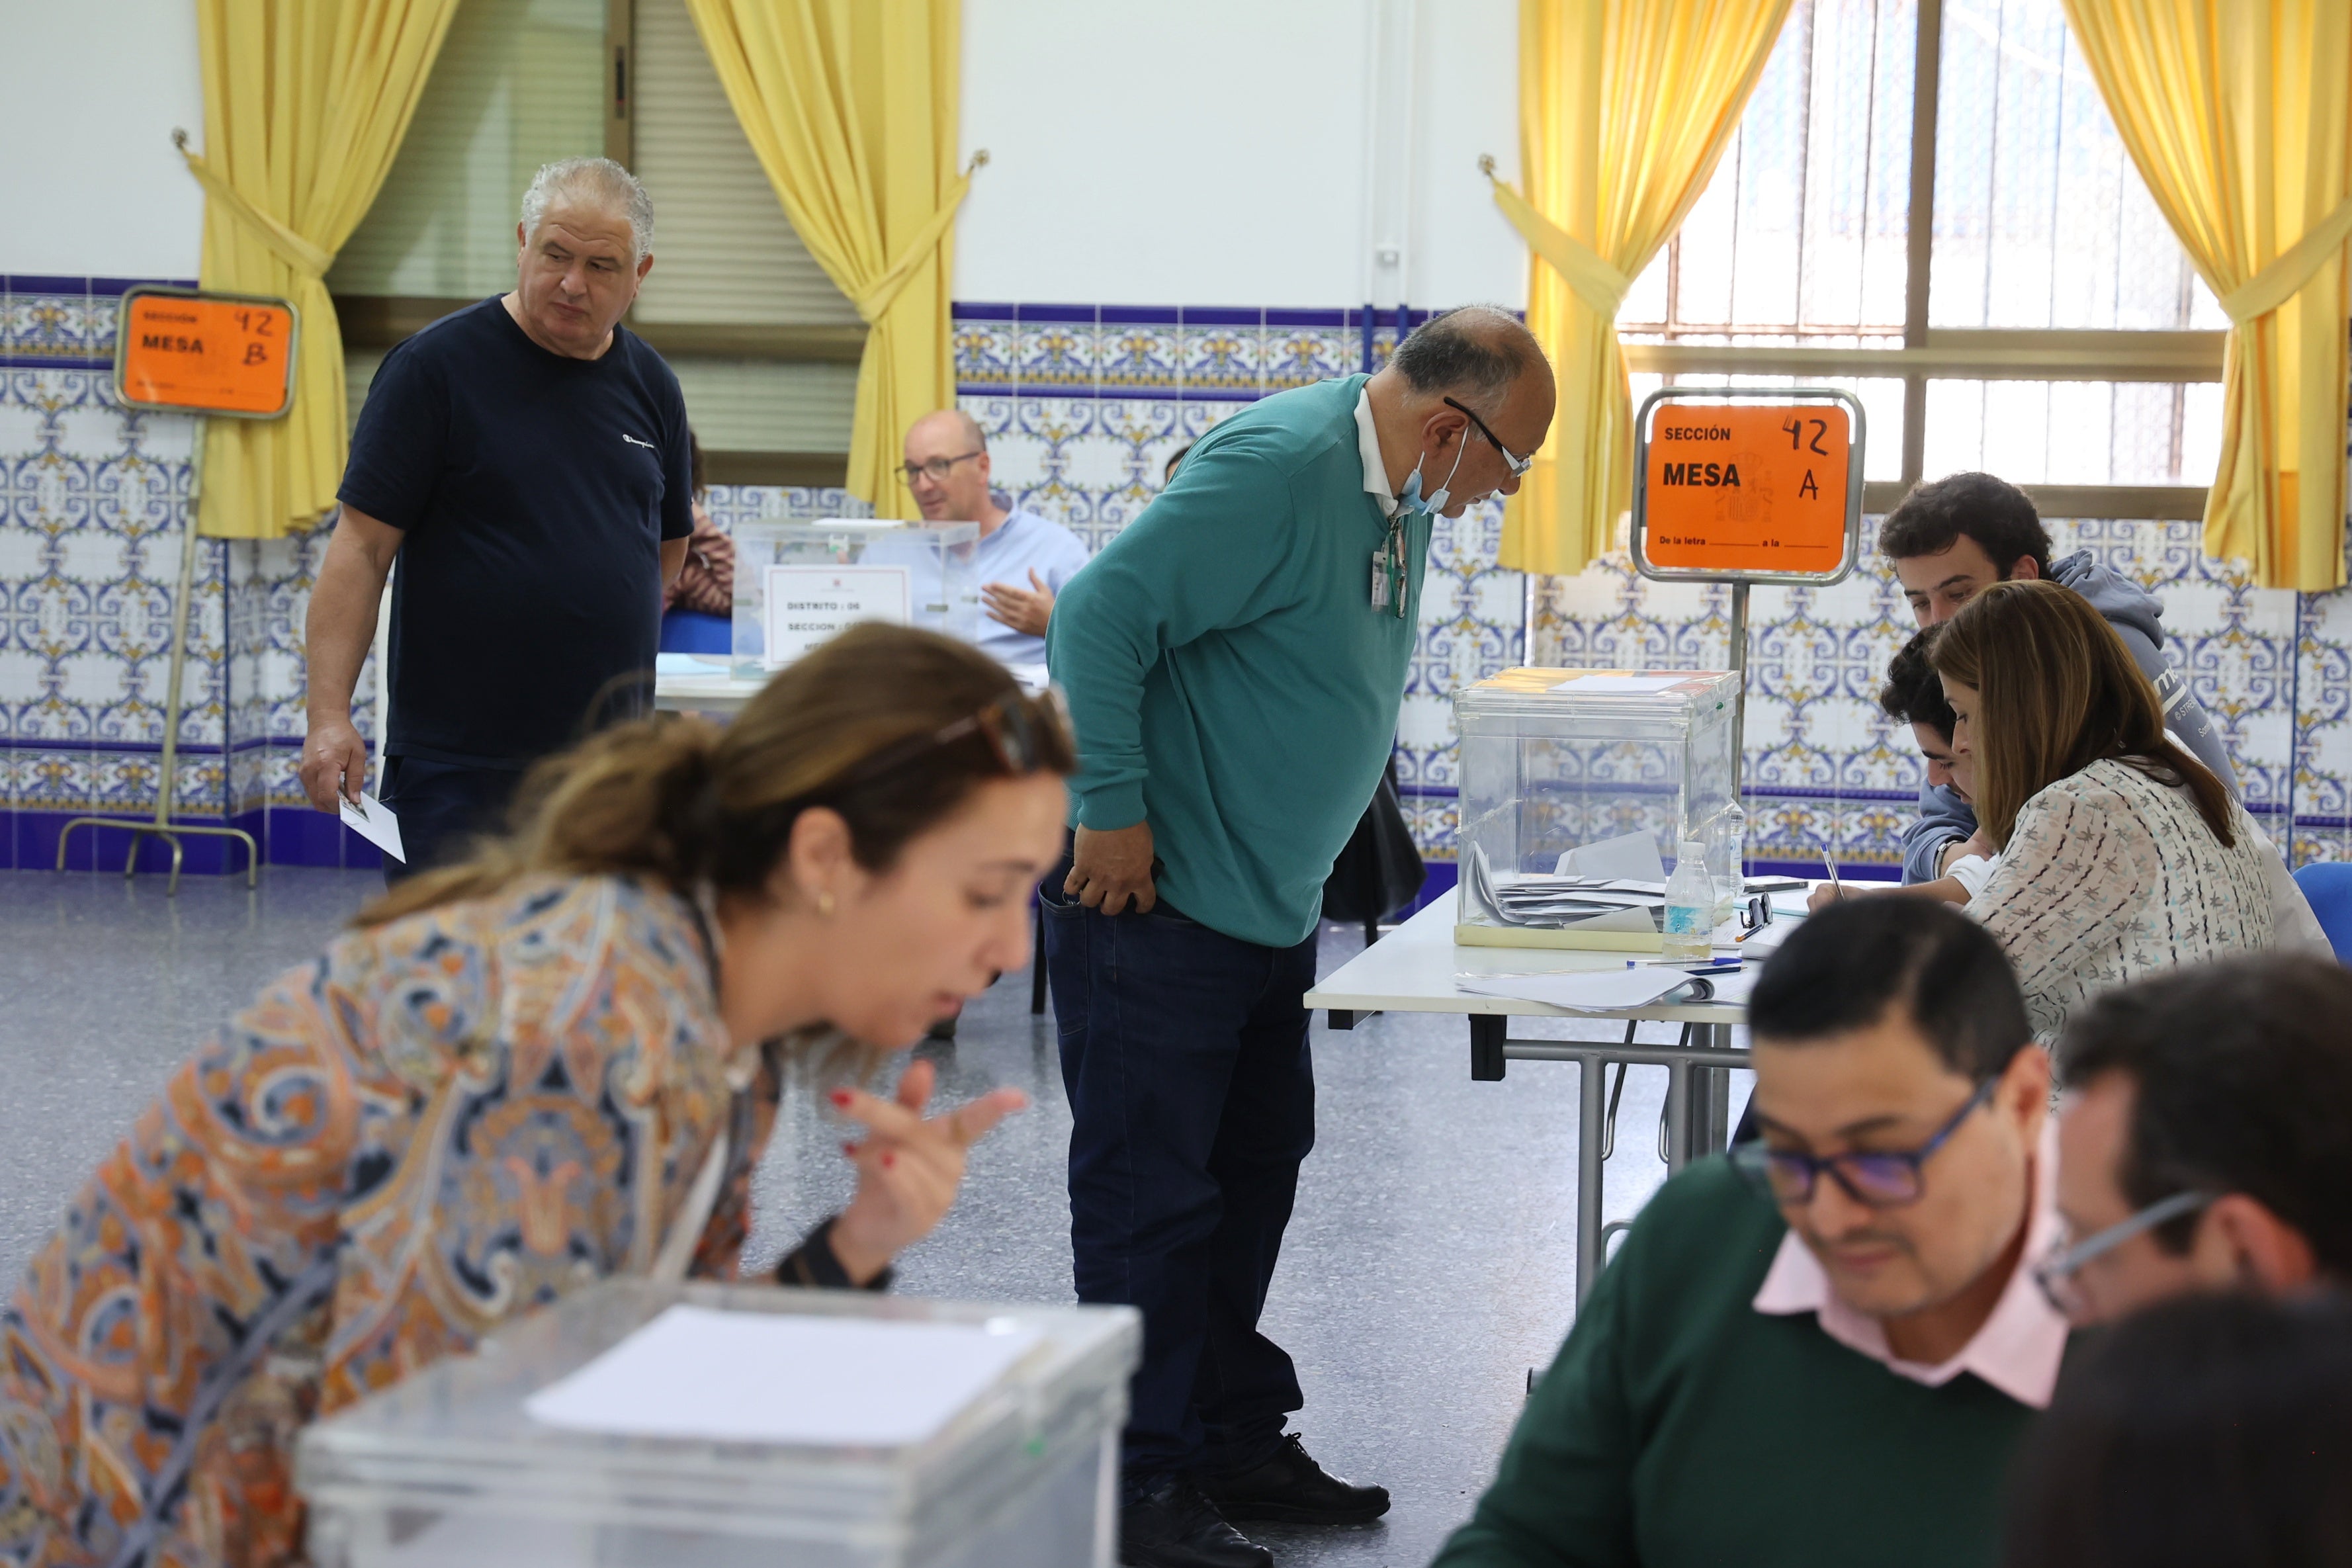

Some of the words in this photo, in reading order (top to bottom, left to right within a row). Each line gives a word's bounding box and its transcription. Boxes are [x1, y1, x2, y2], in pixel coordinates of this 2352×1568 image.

[234, 310, 274, 337] 42
[143, 334, 204, 355] MESA
[241, 342, 269, 367] B
[1664, 423, 1731, 441] SECCIÓN
[1782, 414, 1829, 457] 42
[1663, 462, 1741, 487] MESA
[1798, 468, 1819, 501] A
[1659, 536, 1671, 544] De
[1673, 536, 1681, 545] la
[1684, 537, 1706, 546] letra
[1771, 539, 1780, 548] la
